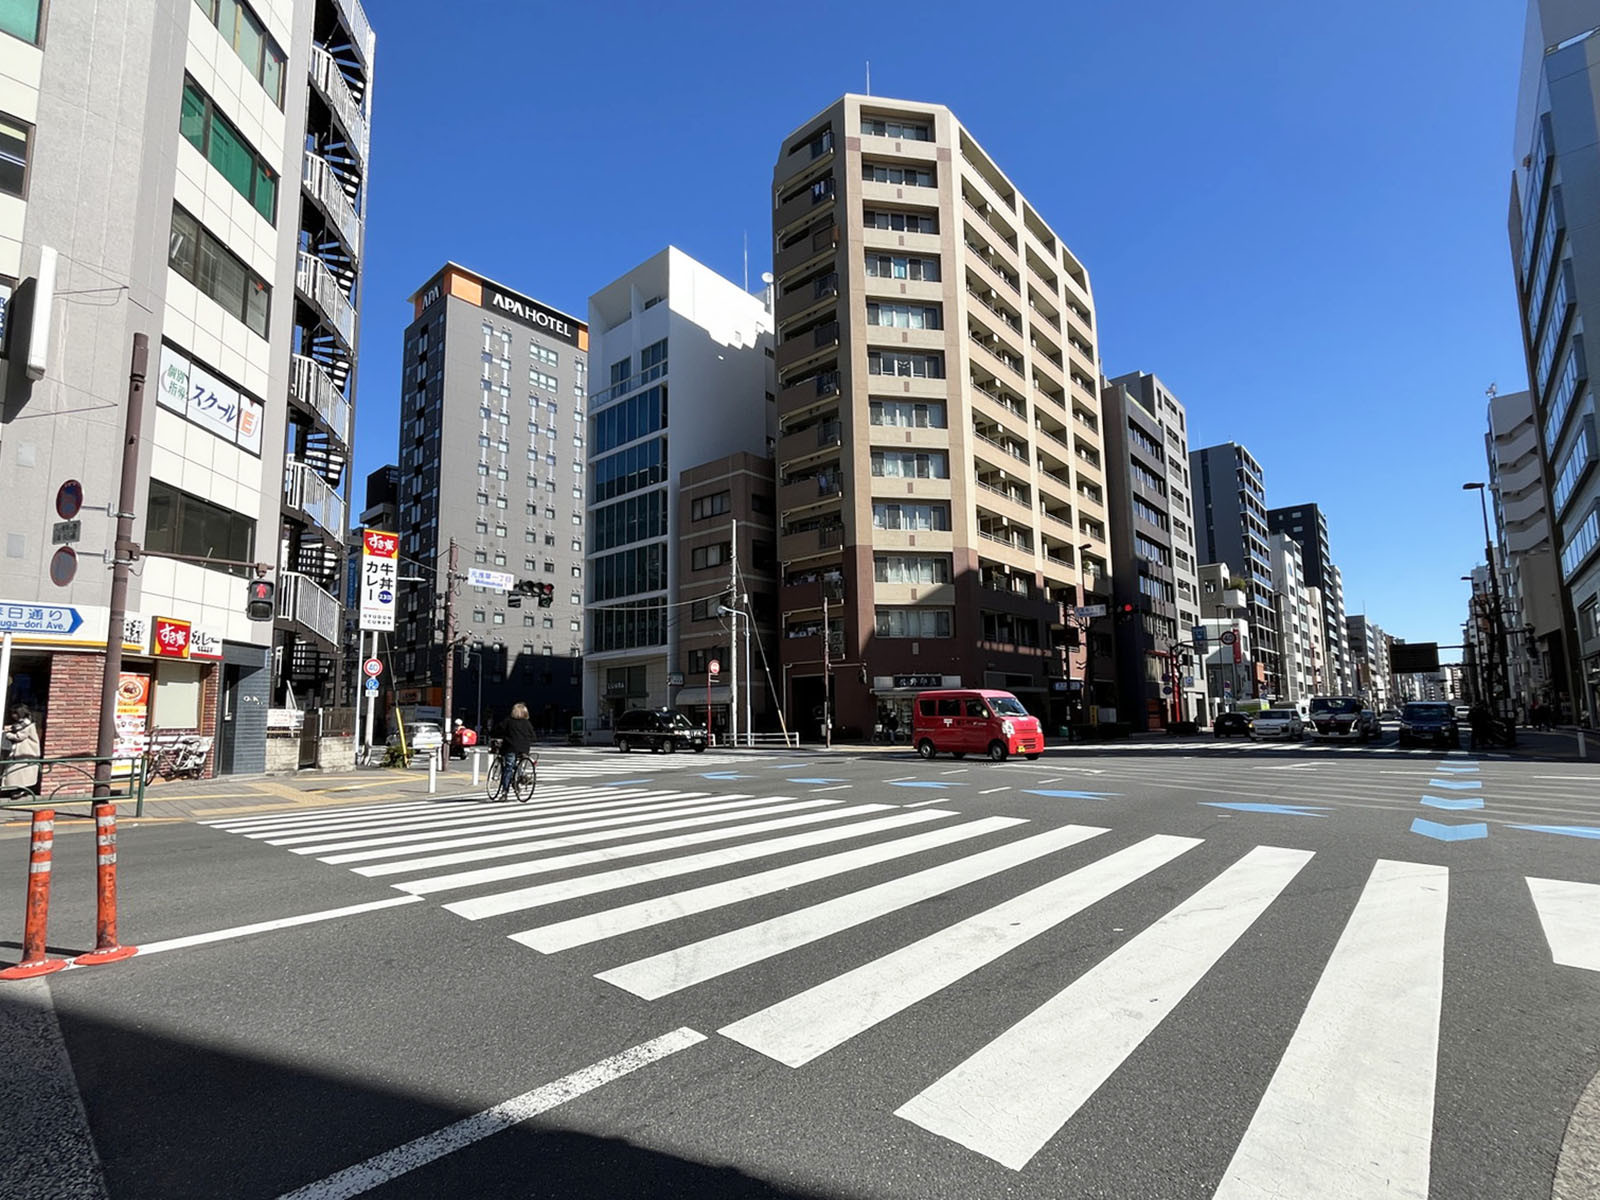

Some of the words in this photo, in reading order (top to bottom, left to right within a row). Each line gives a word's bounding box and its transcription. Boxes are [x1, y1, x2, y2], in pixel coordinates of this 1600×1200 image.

[422, 285, 441, 311] APA
[492, 292, 524, 317] APA
[525, 307, 572, 338] HOTEL
[192, 384, 237, 423] スクール
[366, 561, 379, 601] カレー
[380, 562, 394, 590] 牛丼
[0, 620, 42, 630] uga-dori
[46, 621, 66, 631] Ave.
[368, 663, 379, 672] 40
